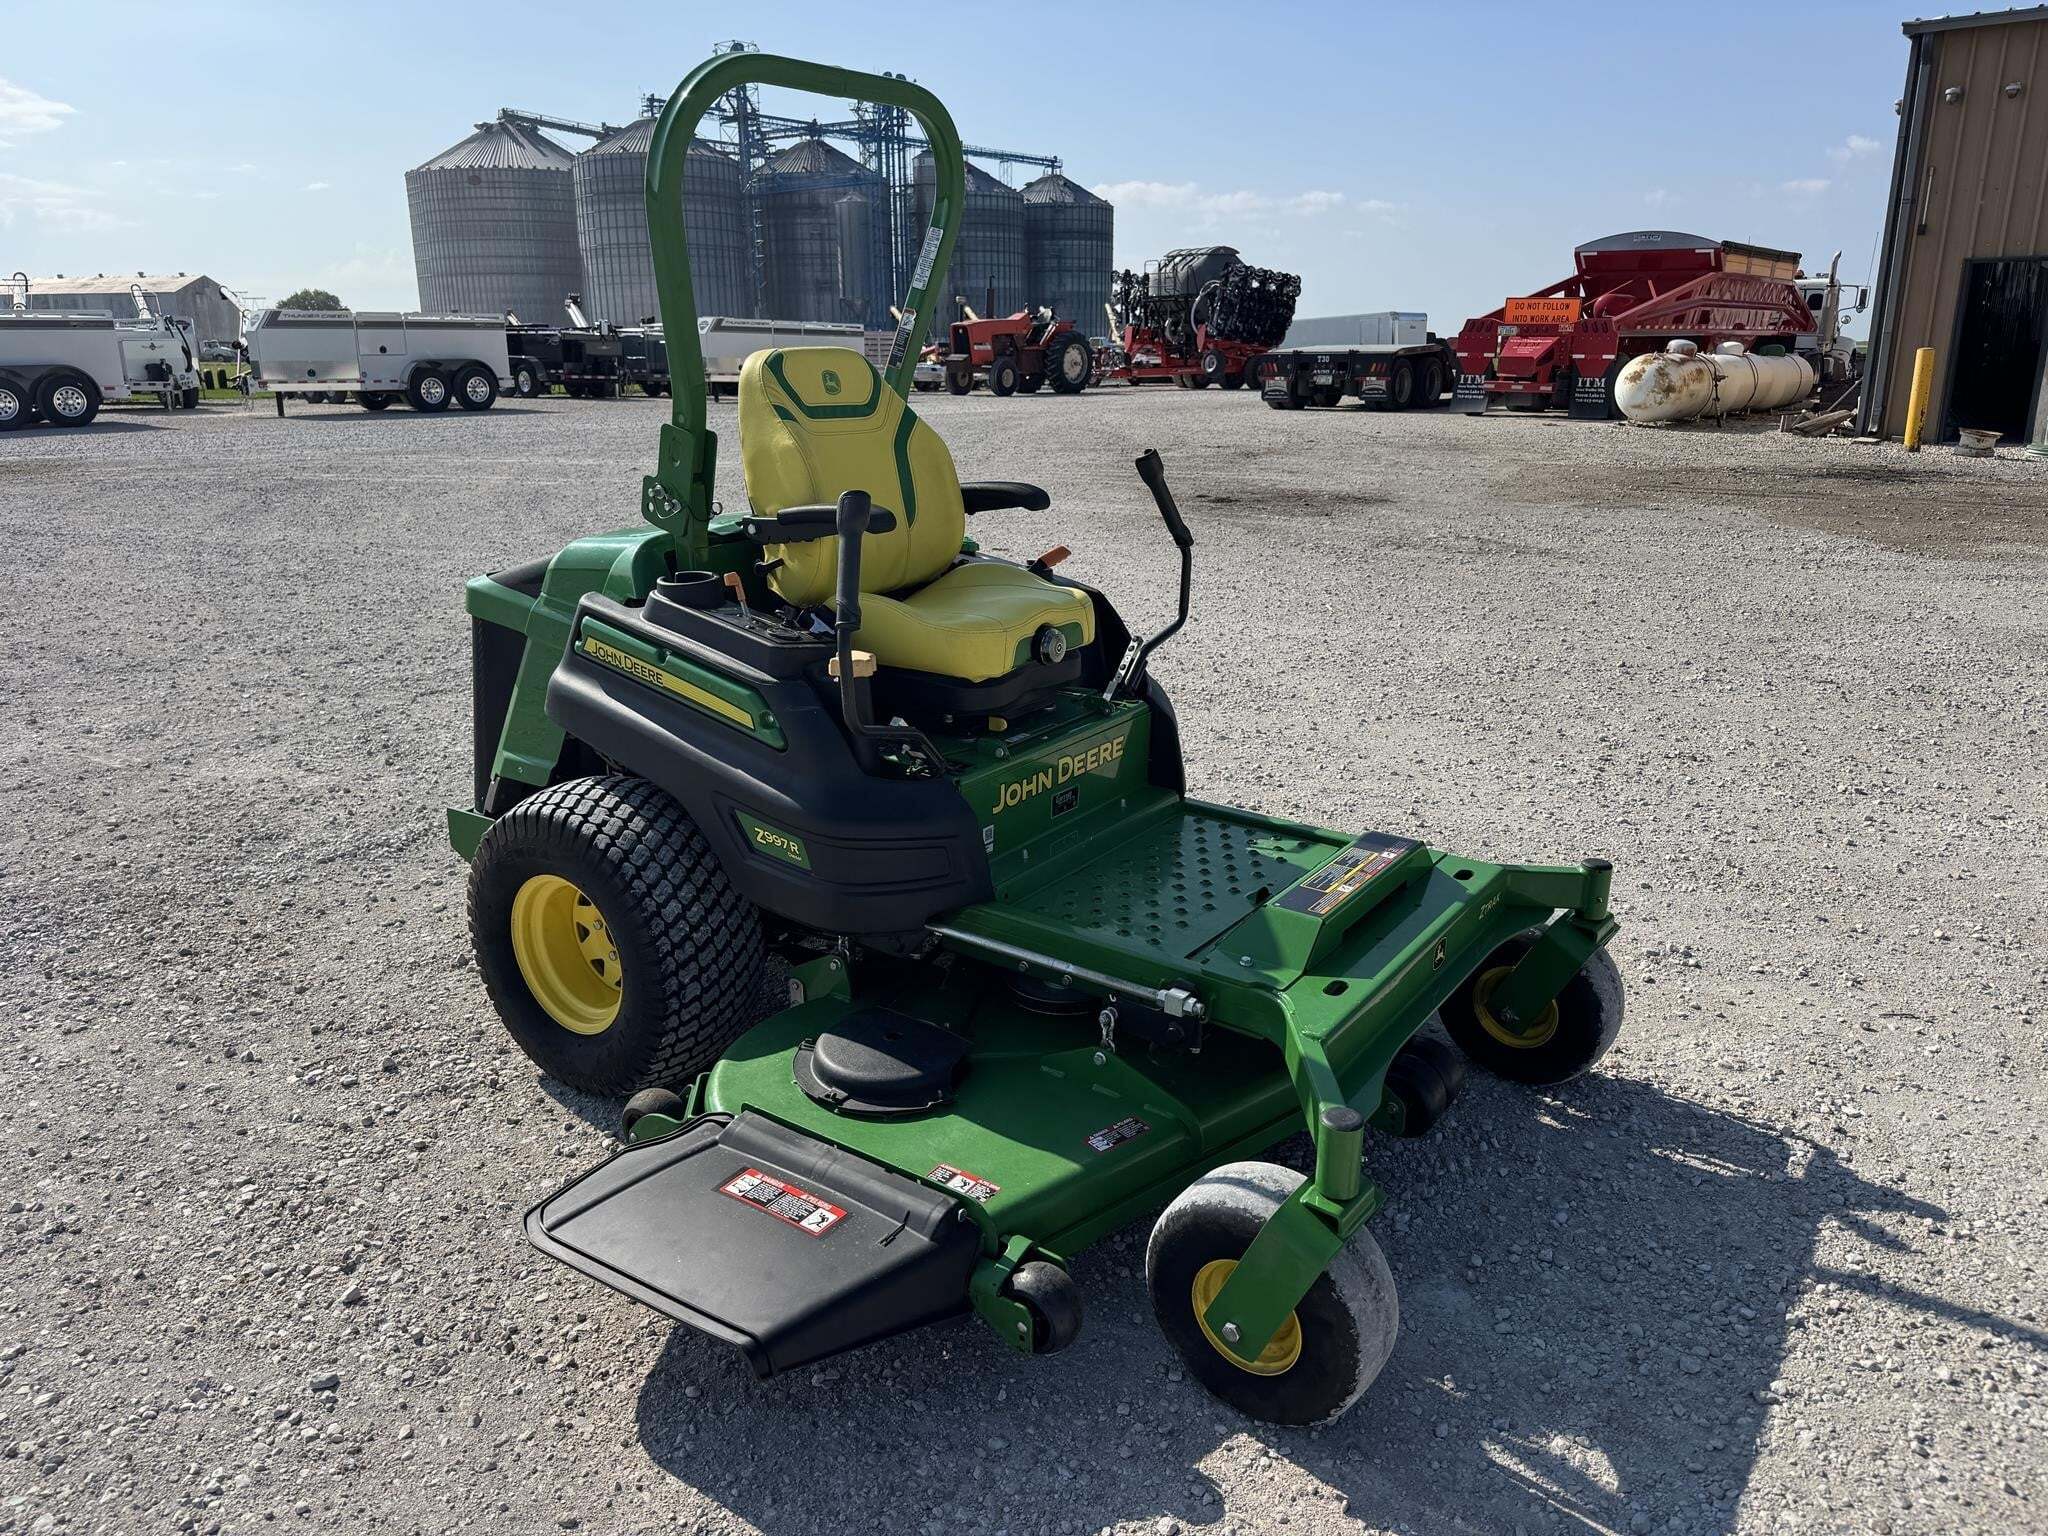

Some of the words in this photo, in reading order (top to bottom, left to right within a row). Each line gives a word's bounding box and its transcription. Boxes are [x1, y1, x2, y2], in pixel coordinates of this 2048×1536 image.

[1515, 302, 1525, 310] DO
[1527, 302, 1541, 310] NOT
[1543, 302, 1571, 310] FOLLOW
[1512, 314, 1528, 323] INTO
[1530, 314, 1550, 323] WORK
[1460, 374, 1487, 384] ITM
[1577, 377, 1606, 388] ITM
[591, 641, 624, 668] JOHN
[623, 654, 664, 685] DEERE
[992, 767, 1053, 815] JOHN
[1057, 735, 1126, 785] DEERE
